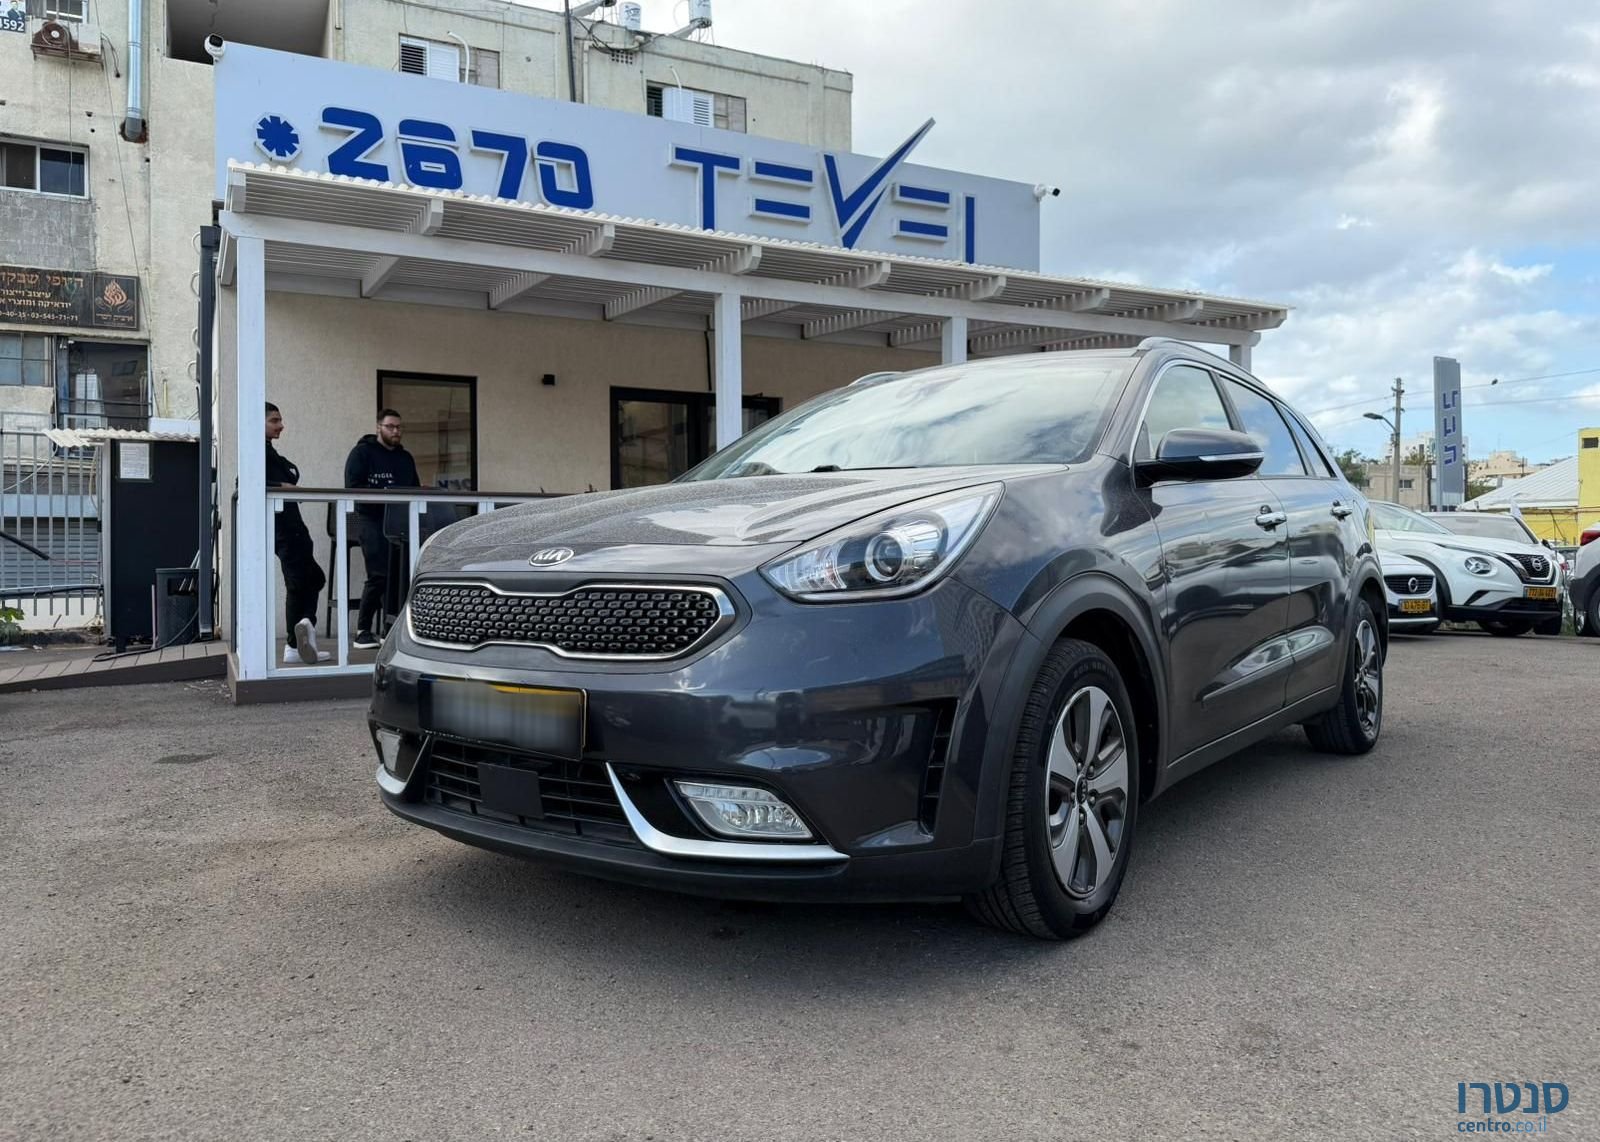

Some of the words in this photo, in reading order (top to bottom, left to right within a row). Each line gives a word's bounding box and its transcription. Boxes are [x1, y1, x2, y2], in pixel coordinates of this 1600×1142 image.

[0, 17, 25, 31] 592
[27, 290, 52, 299] עיצוב
[531, 548, 570, 563] KIA
